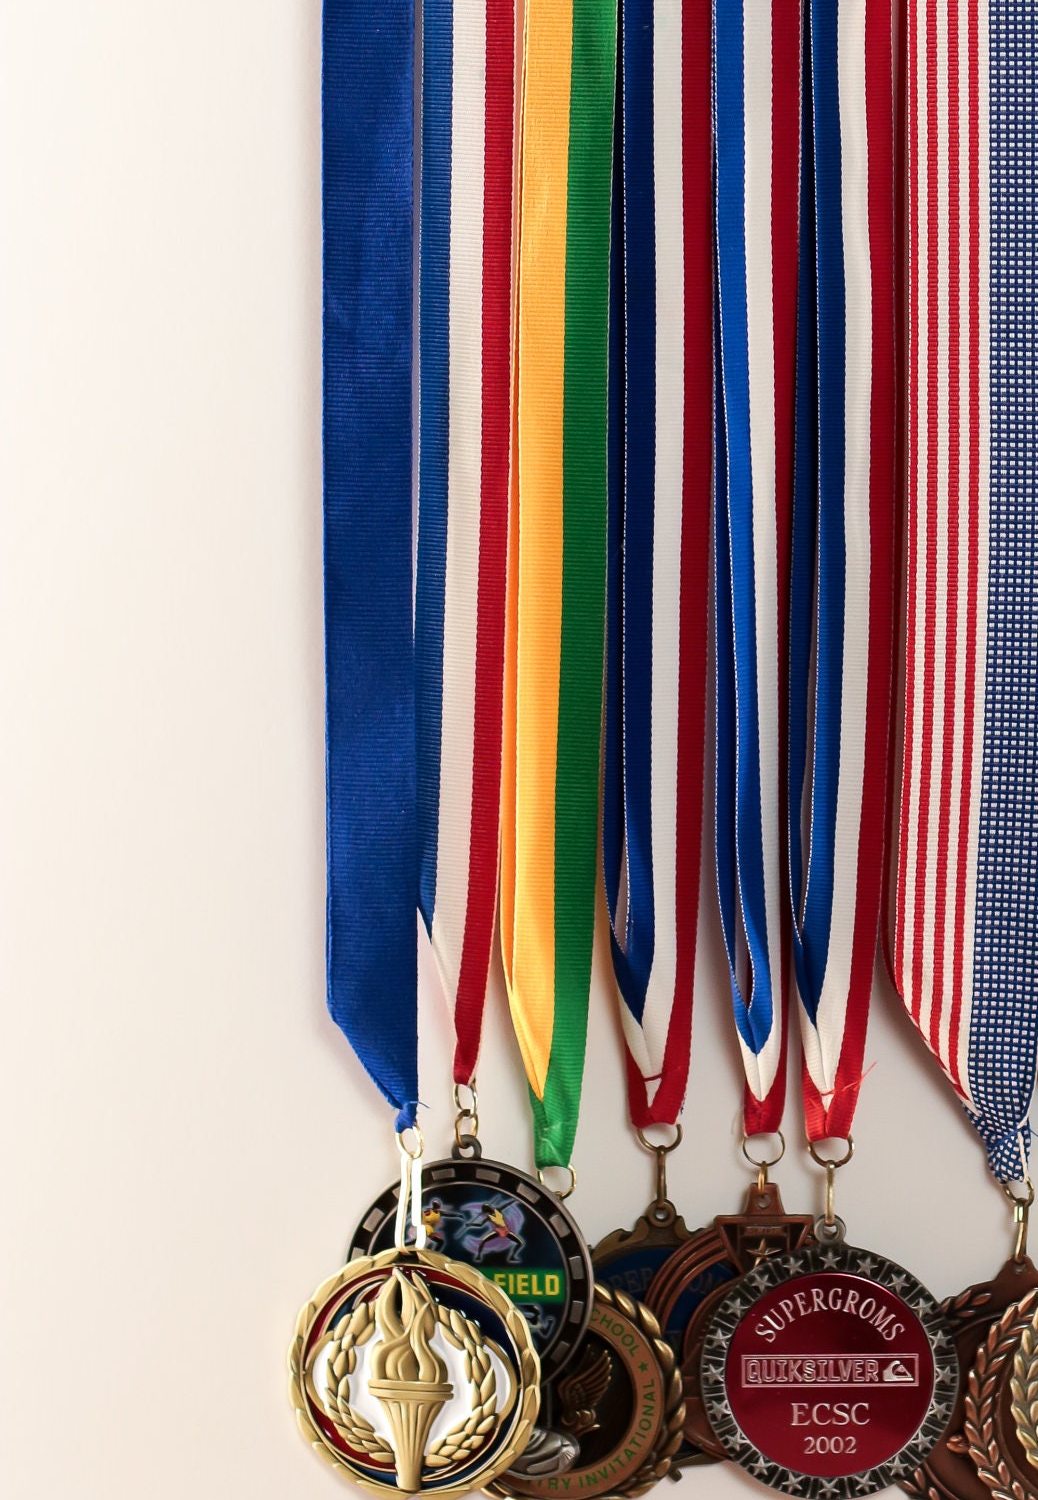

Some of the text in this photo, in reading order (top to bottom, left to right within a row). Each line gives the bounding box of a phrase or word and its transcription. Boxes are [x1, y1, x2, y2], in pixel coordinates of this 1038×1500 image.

[493, 1273, 560, 1296] FIELD
[754, 1287, 906, 1343] SUPERGROMS
[590, 1307, 641, 1358] CHOOL
[746, 1358, 879, 1384] QUIKSILVER
[790, 1402, 870, 1427] ECSC
[578, 1378, 656, 1489] INVITATIONAL
[804, 1436, 857, 1454] 2002
